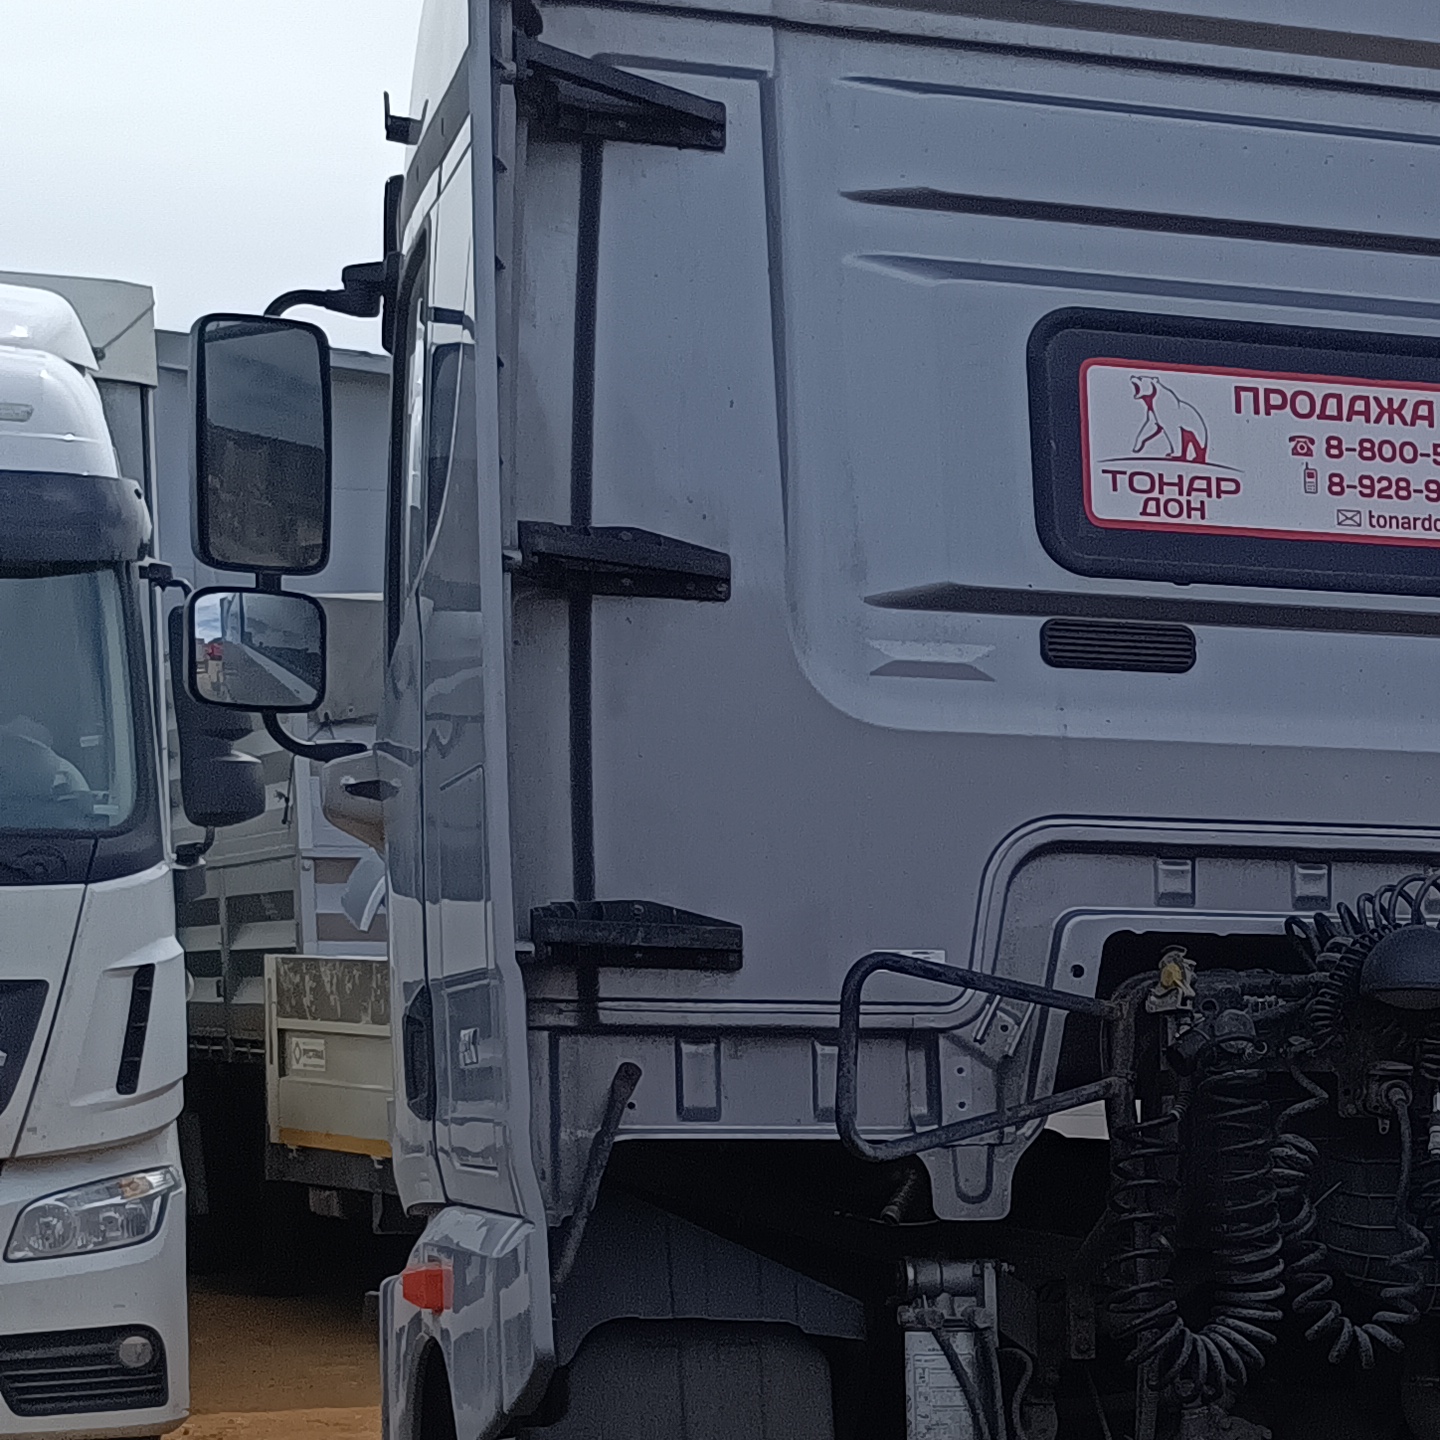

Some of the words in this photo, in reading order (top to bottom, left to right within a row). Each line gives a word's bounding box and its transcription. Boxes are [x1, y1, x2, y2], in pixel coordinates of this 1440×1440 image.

[1234, 386, 1434, 428] ПРОДАЖА
[1101, 469, 1242, 498] ТОНАР
[1139, 499, 1207, 520] ДОН
